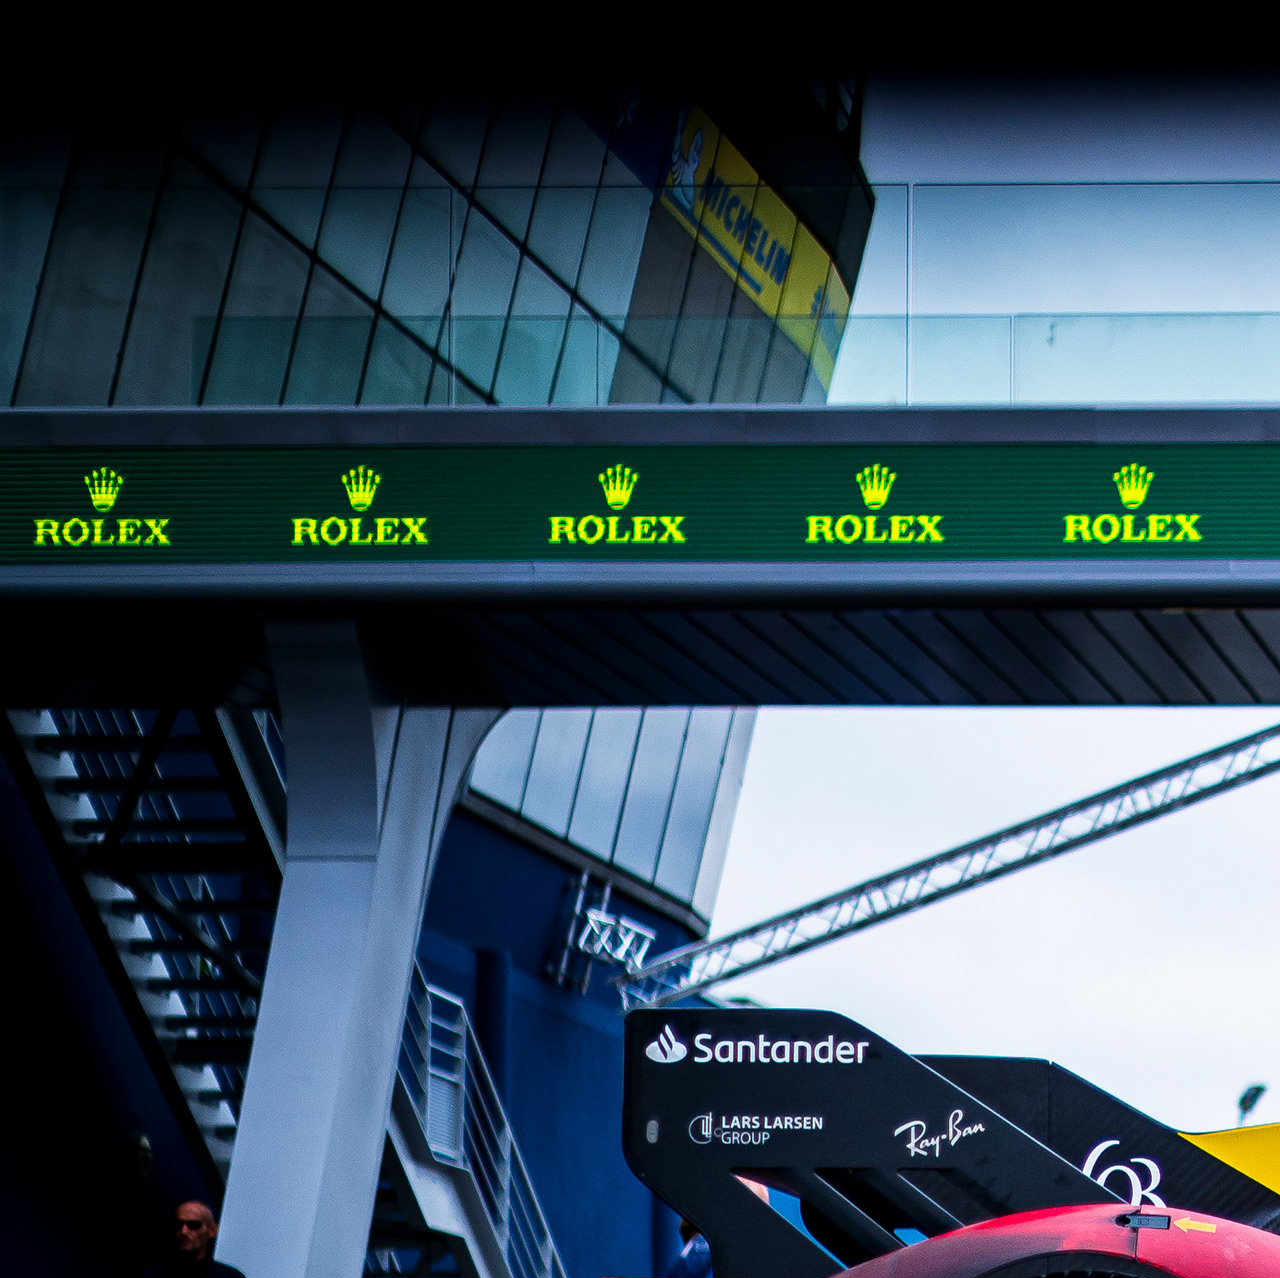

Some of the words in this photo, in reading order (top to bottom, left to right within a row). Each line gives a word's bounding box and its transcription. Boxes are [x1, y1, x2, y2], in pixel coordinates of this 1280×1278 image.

[700, 167, 793, 286] MICHELIN
[33, 517, 171, 547] ROLEX
[291, 515, 429, 546] ROLEX
[549, 514, 686, 546] ROLEX
[805, 513, 944, 544] ROLEX
[1064, 513, 1202, 543] ROLEX
[693, 1033, 870, 1063] Santander
[721, 1115, 761, 1130] LARS
[764, 1115, 824, 1131] LARSEN
[721, 1131, 771, 1145] GROUP
[894, 1108, 986, 1158] Ray-Ban
